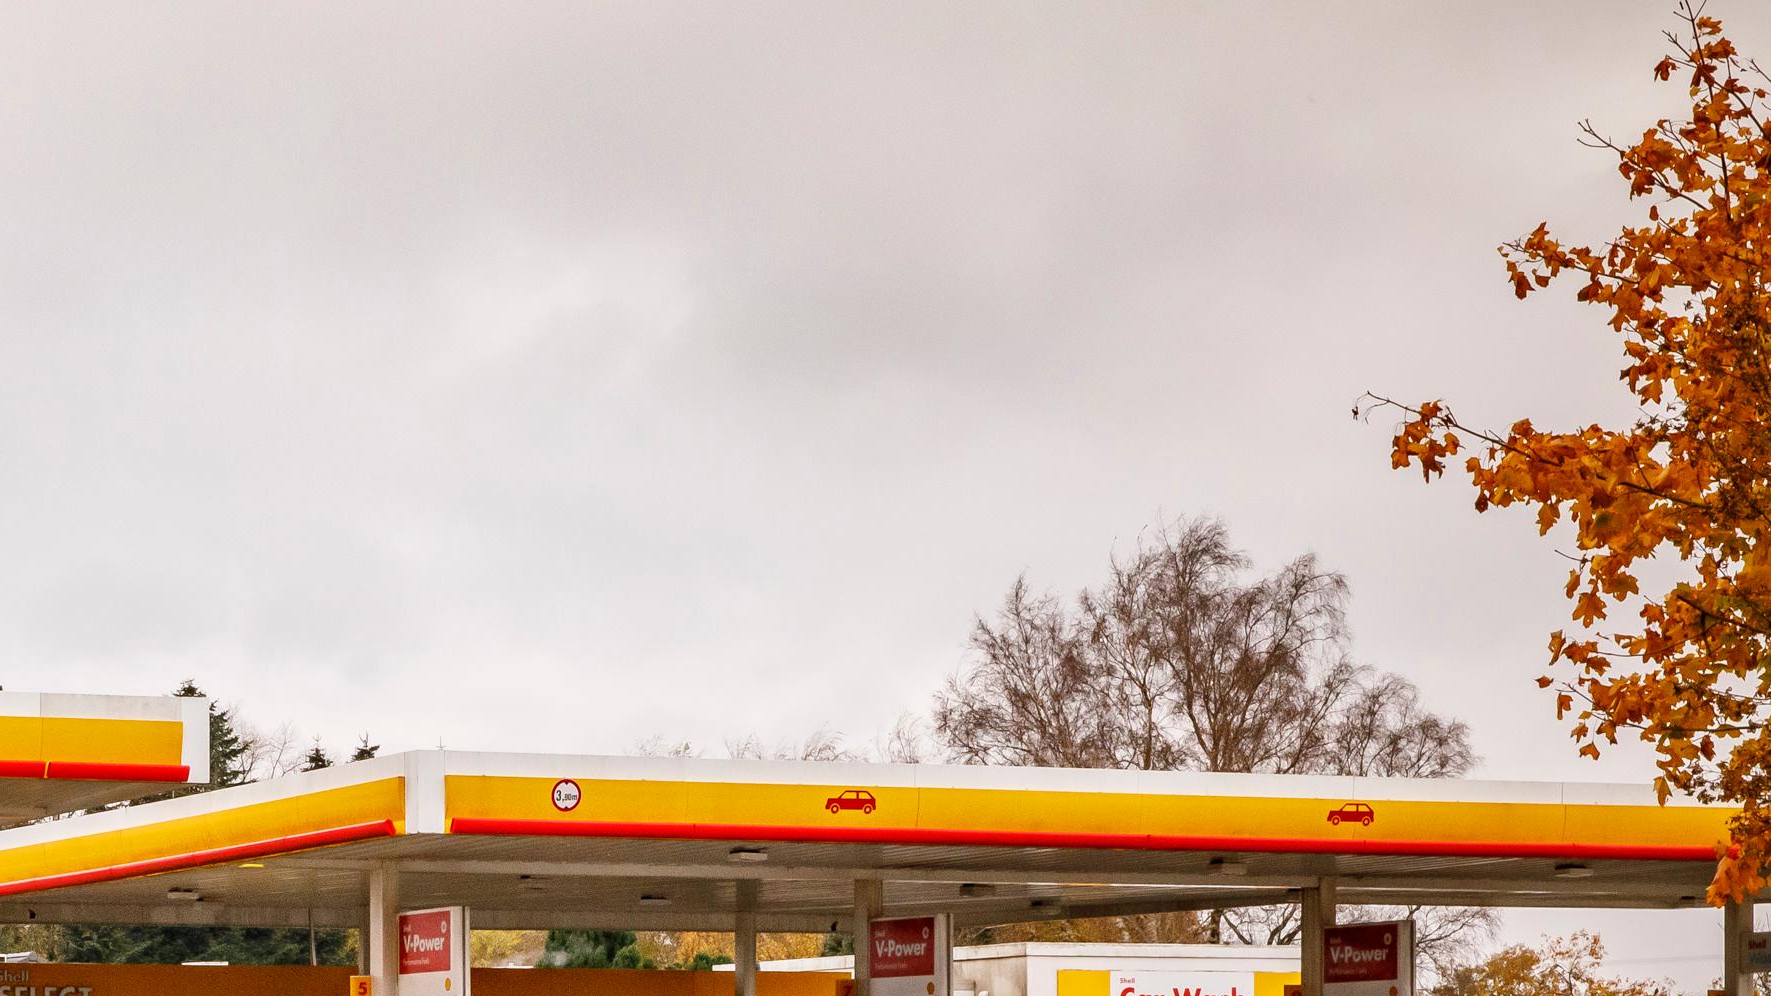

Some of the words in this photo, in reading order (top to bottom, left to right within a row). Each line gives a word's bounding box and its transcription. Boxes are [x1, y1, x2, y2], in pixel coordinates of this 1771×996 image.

[403, 934, 445, 953] V-Power
[875, 939, 926, 958] V-Power
[1330, 946, 1389, 963] V-Power
[358, 982, 368, 996] 5
